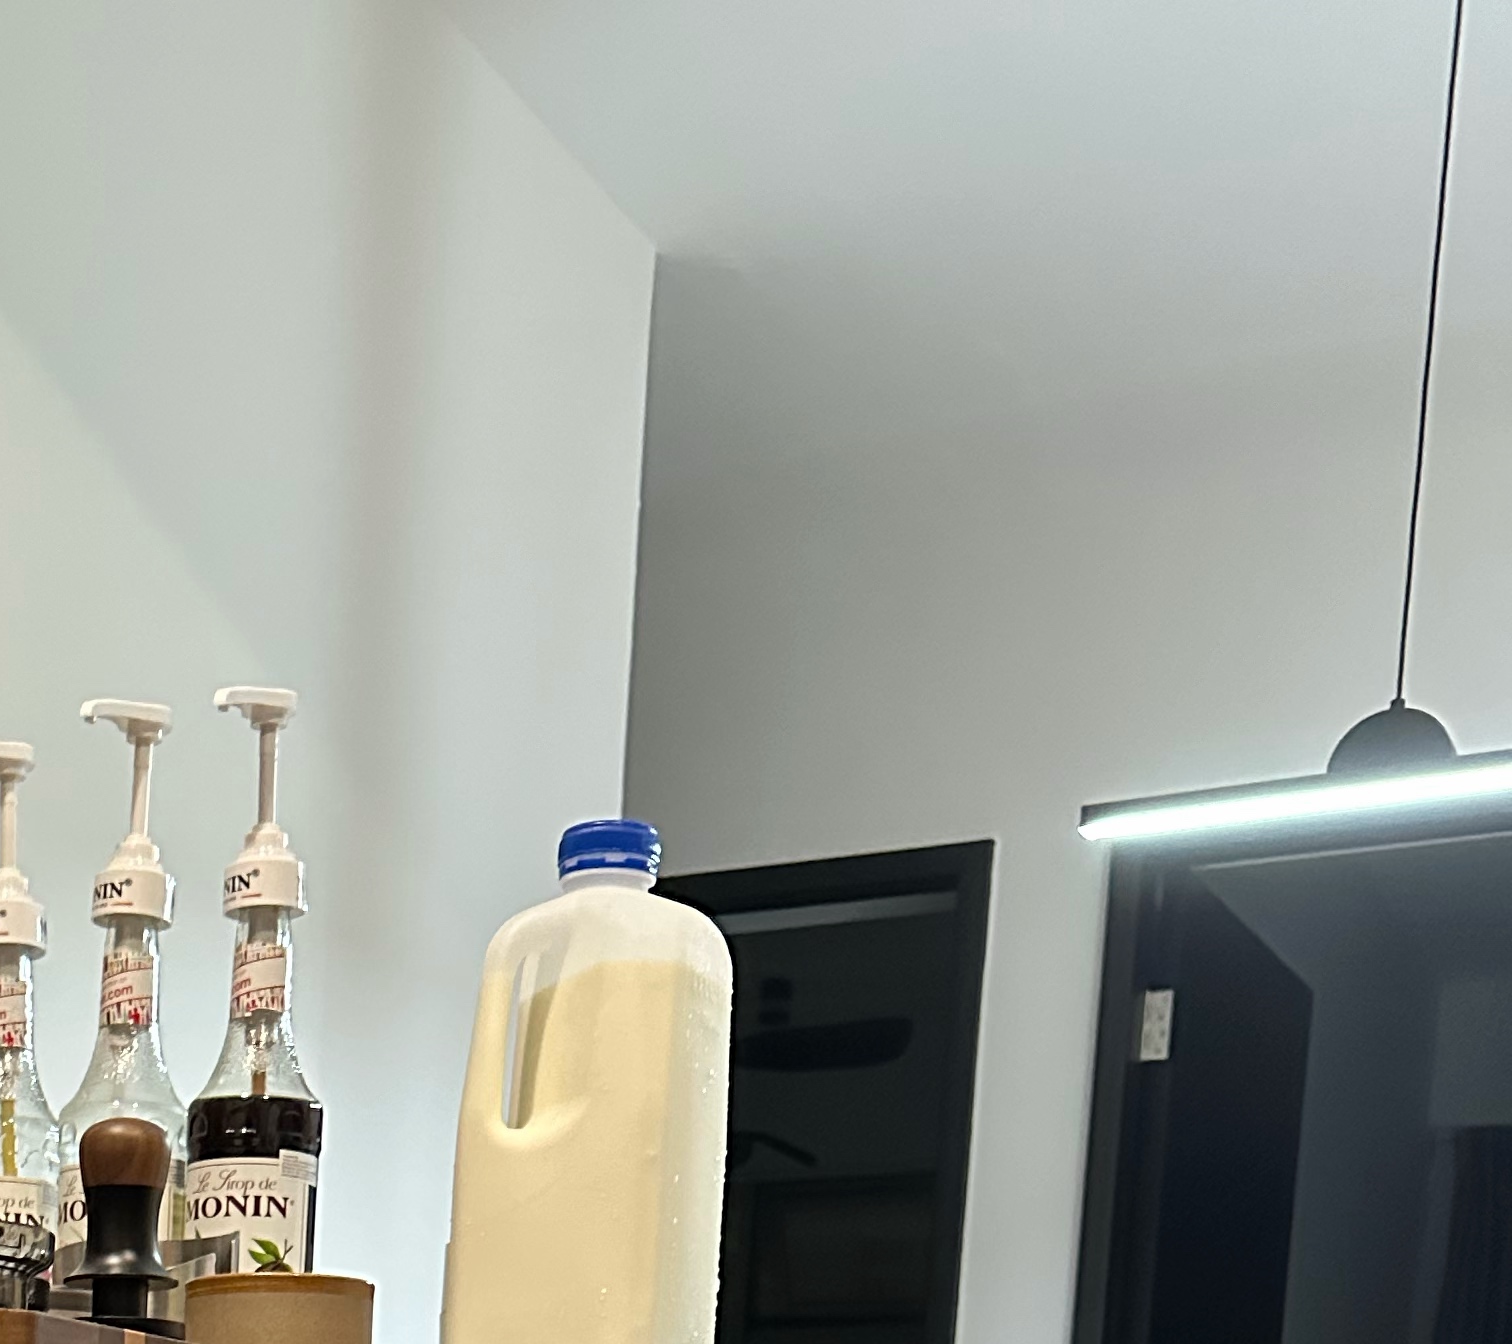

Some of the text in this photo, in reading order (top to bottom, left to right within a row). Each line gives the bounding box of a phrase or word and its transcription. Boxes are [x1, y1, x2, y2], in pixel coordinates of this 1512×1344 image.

[212, 1169, 254, 1195] Sirop
[258, 1178, 278, 1190] de
[18, 1196, 35, 1208] de
[187, 1195, 289, 1221] MONIN
